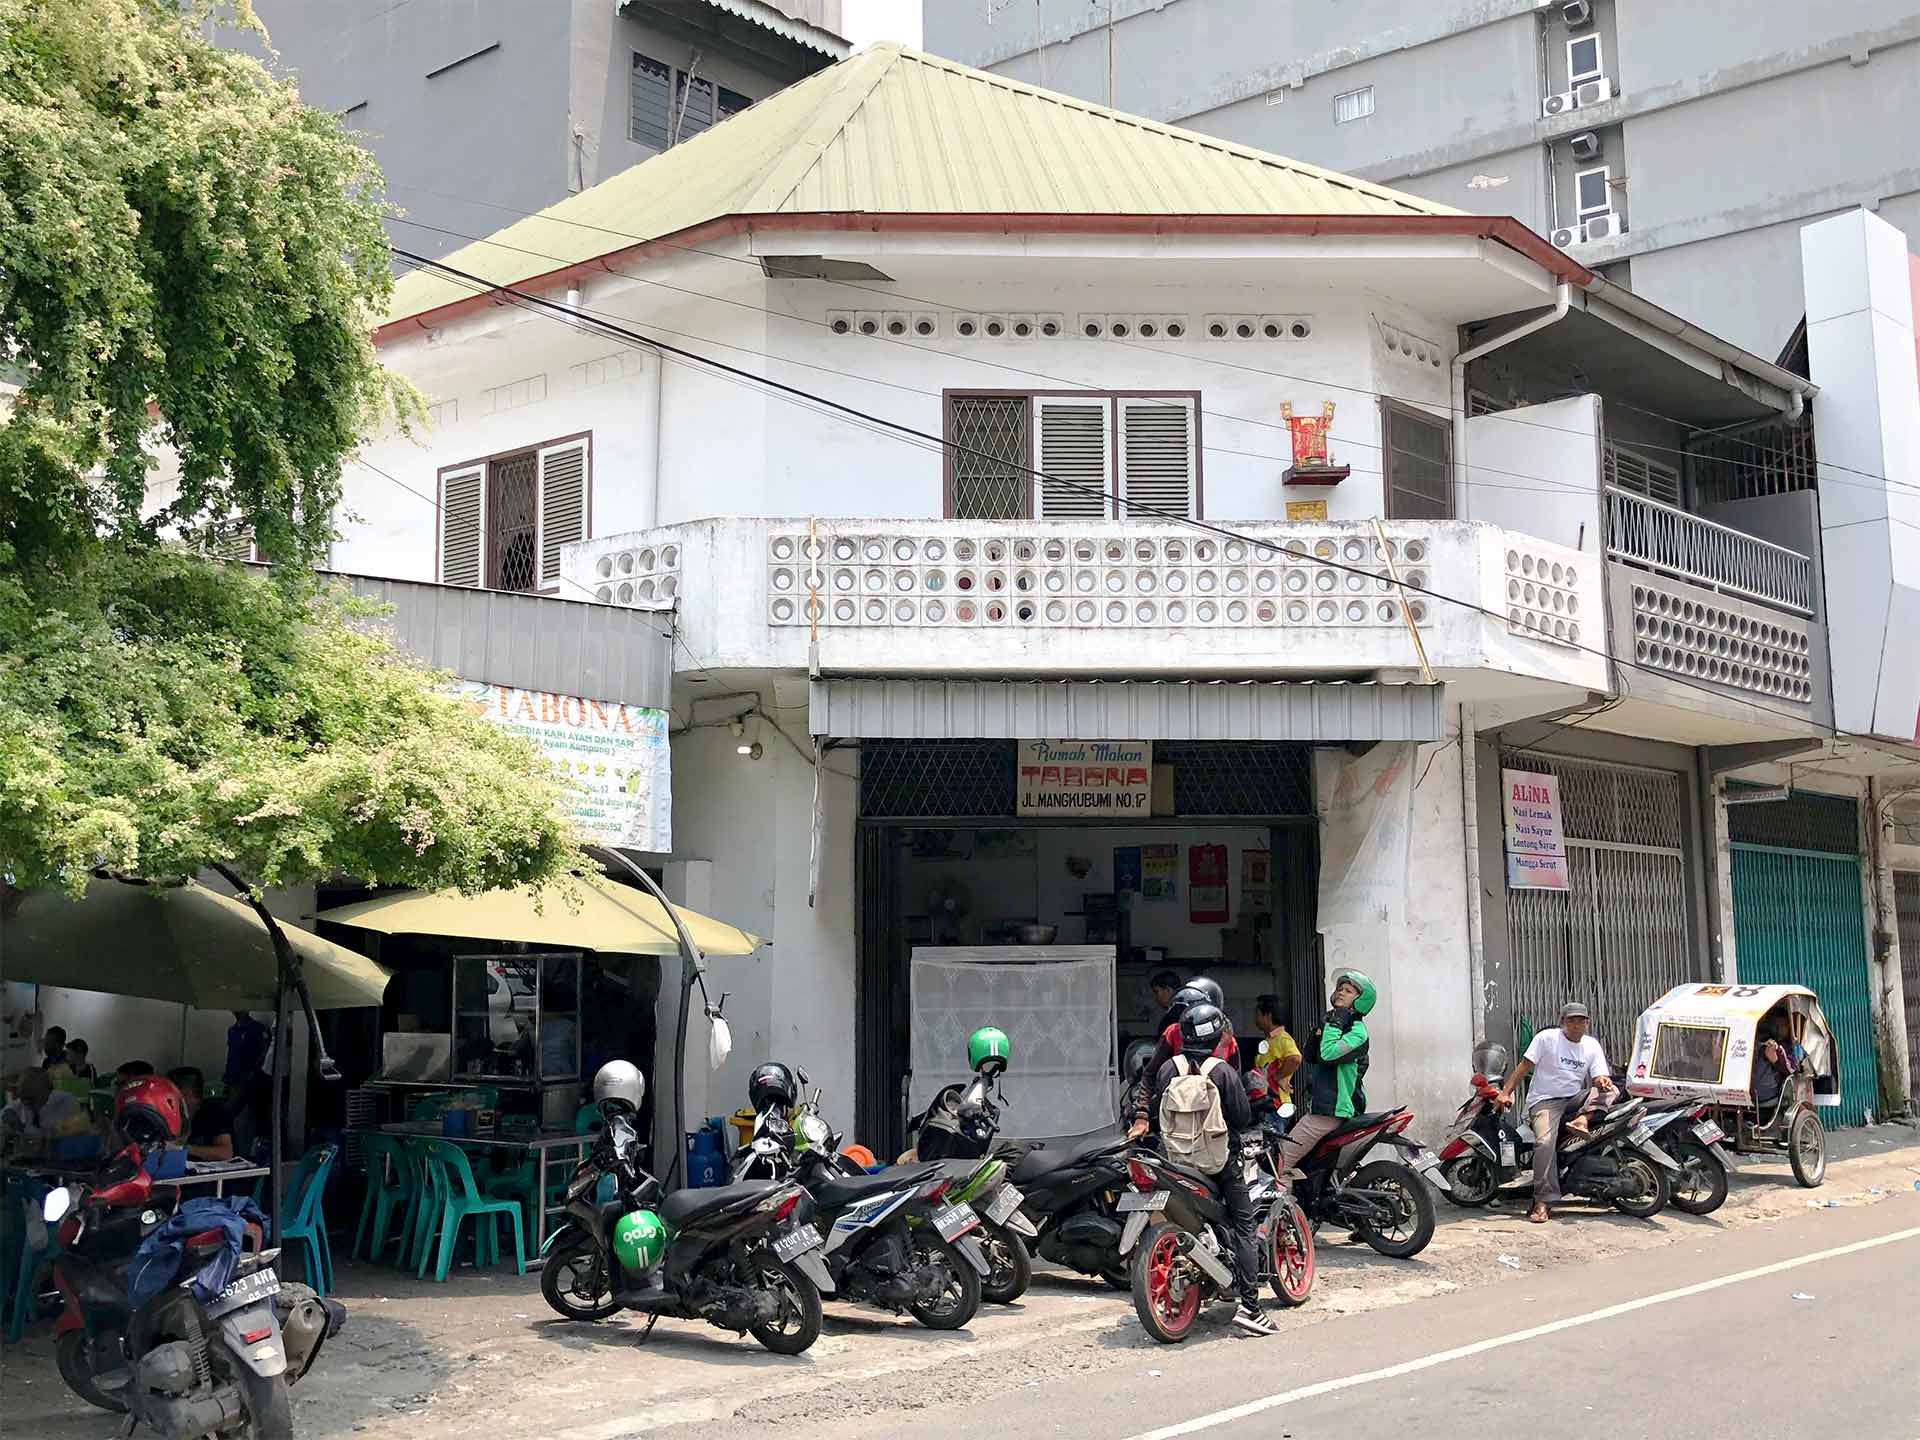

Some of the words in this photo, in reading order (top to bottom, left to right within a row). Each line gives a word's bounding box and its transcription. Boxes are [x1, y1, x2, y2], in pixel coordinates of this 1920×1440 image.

[492, 685, 634, 733] TABONA
[1030, 739, 1085, 761] Rumah
[1089, 743, 1143, 762] Makan
[1021, 766, 1148, 787] TABONA
[1512, 806, 1528, 817] Nasi
[1515, 823, 1530, 834] Nasi
[623, 1225, 657, 1246] Grab
[254, 1268, 277, 1287] AHA
